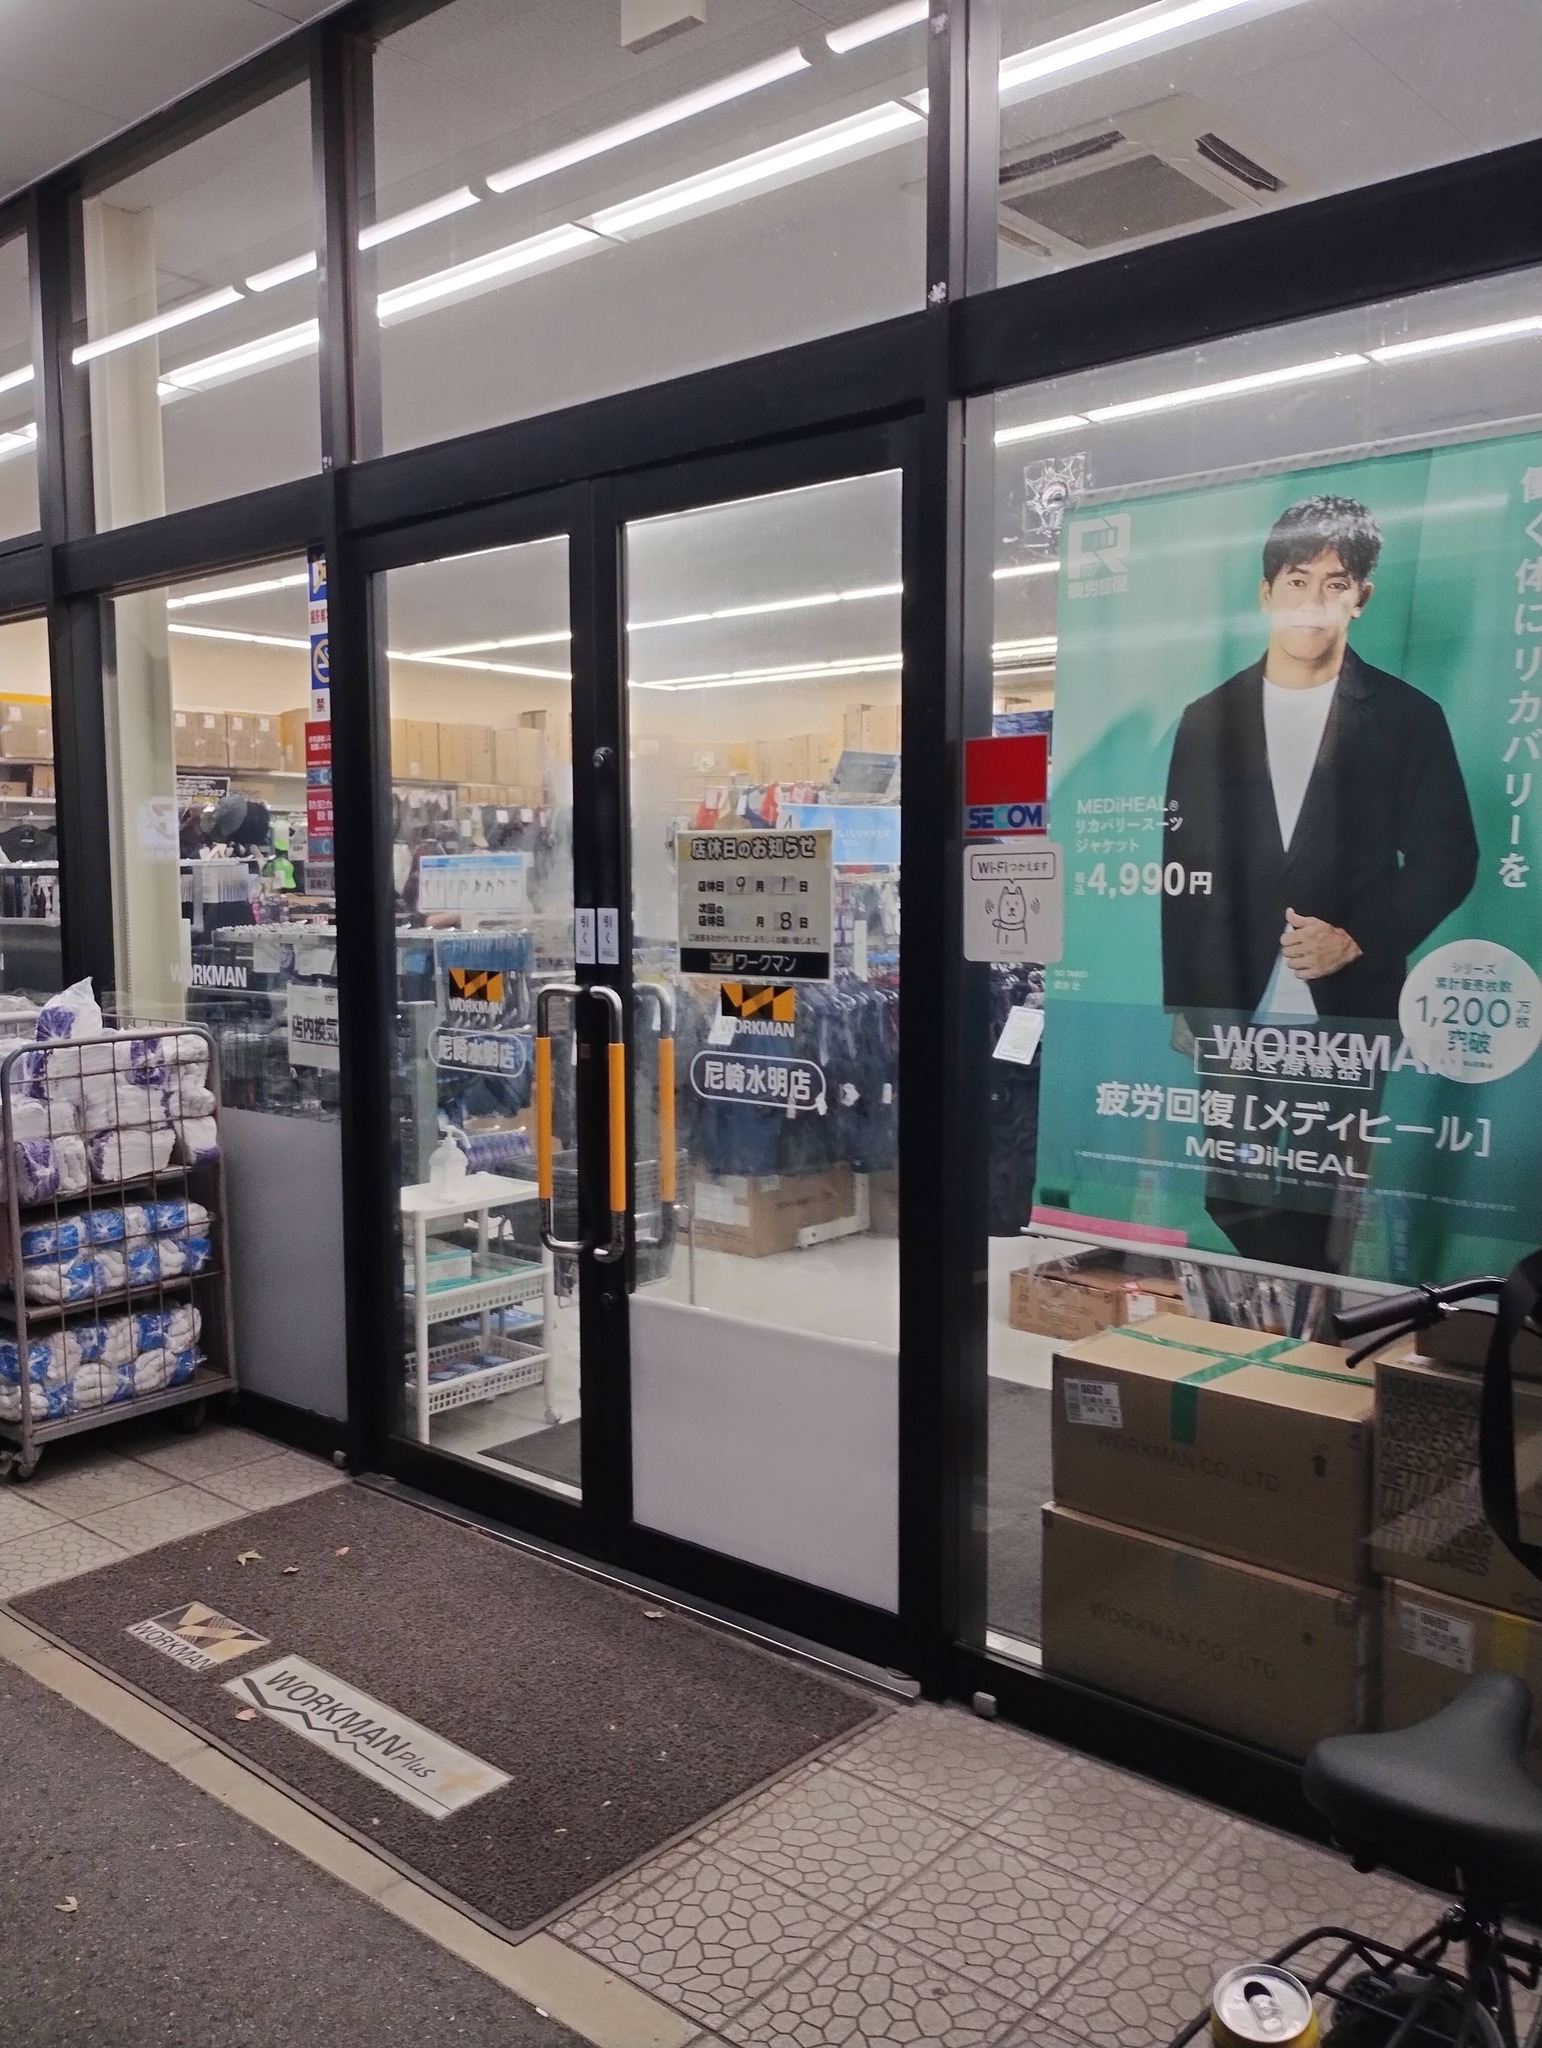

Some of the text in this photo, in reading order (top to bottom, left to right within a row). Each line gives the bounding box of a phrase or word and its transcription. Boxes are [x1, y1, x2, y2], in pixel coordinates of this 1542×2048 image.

[969, 804, 1043, 829] SECOM
[691, 836, 817, 860] 店休日のお知らせ
[1076, 837, 1139, 853] ジャケット
[698, 881, 725, 893] 店休日
[756, 881, 765, 892] 月
[799, 881, 808, 892] 日
[698, 903, 724, 914] 次回の
[698, 911, 808, 930] 店休日 月 8 日
[735, 953, 798, 974] ワークマン
[1452, 962, 1497, 975] シリーズ
[450, 999, 503, 1015] WORKMAN
[1416, 994, 1510, 1029] 1,200
[719, 1017, 795, 1038] WORKMAN
[438, 1035, 515, 1070] 尼崎水明店
[1447, 1028, 1492, 1055] 突破
[704, 1060, 812, 1101] 尼崎水明店
[131, 1622, 217, 1669] WORKMAN
[265, 1669, 411, 1757] WORKMAN
